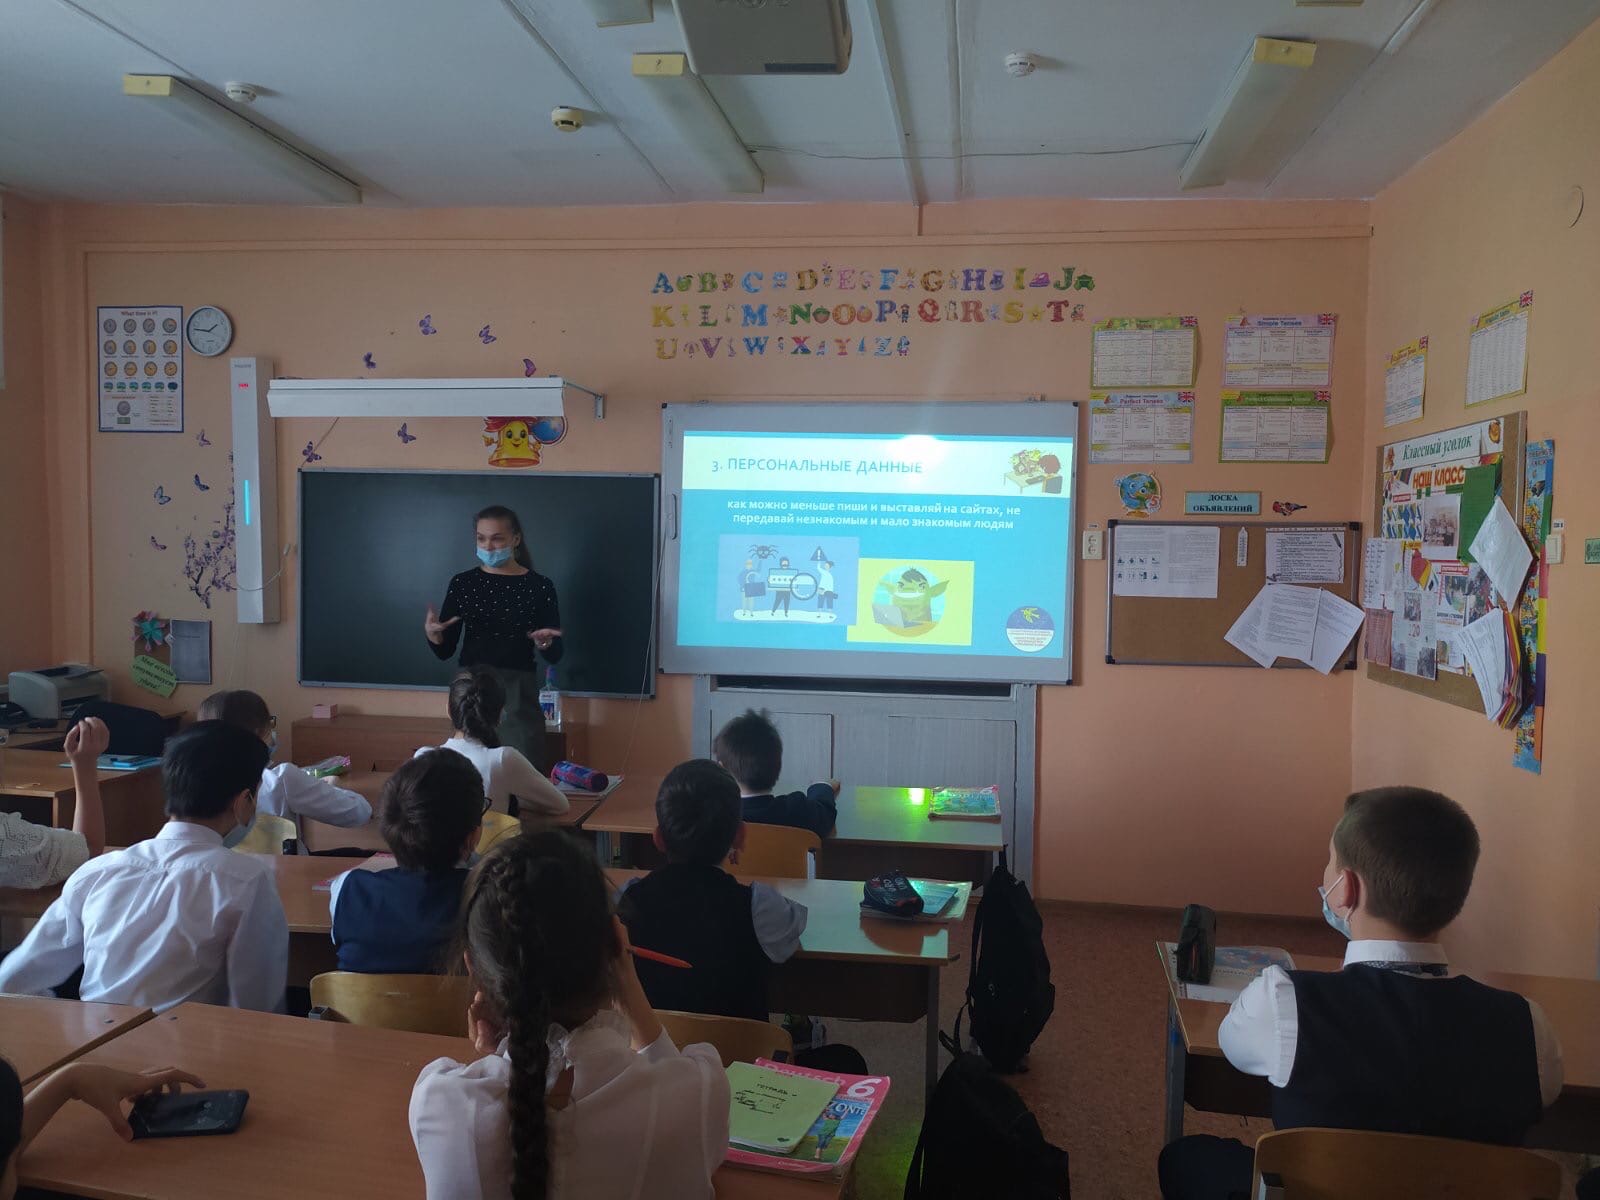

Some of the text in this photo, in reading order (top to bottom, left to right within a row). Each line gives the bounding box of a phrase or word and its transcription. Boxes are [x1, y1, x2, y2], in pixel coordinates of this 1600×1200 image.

[652, 267, 1075, 293] A B C D E F G H I J
[652, 298, 1069, 327] K L M N O P Q R S T
[655, 336, 892, 360] U V W X Y Z
[1403, 435, 1473, 460] Классный уголок
[712, 458, 923, 475] 3. ПЕРСОНАЛЬНЫЕ ДАННЫЕ
[1208, 494, 1238, 502] ДОСКА
[727, 500, 746, 509] как
[749, 501, 788, 510] можно
[790, 502, 835, 511] меньше
[838, 503, 868, 512] пиши
[870, 504, 878, 512] и
[880, 503, 942, 513] выставляй
[943, 506, 958, 514] на
[960, 504, 1003, 517] сайтах,
[1193, 505, 1253, 513] ОБЪЯВЛЕНИЙ
[733, 513, 1014, 532] передавай незнакомым и мало знакомым людям
[847, 1078, 882, 1098] 6
